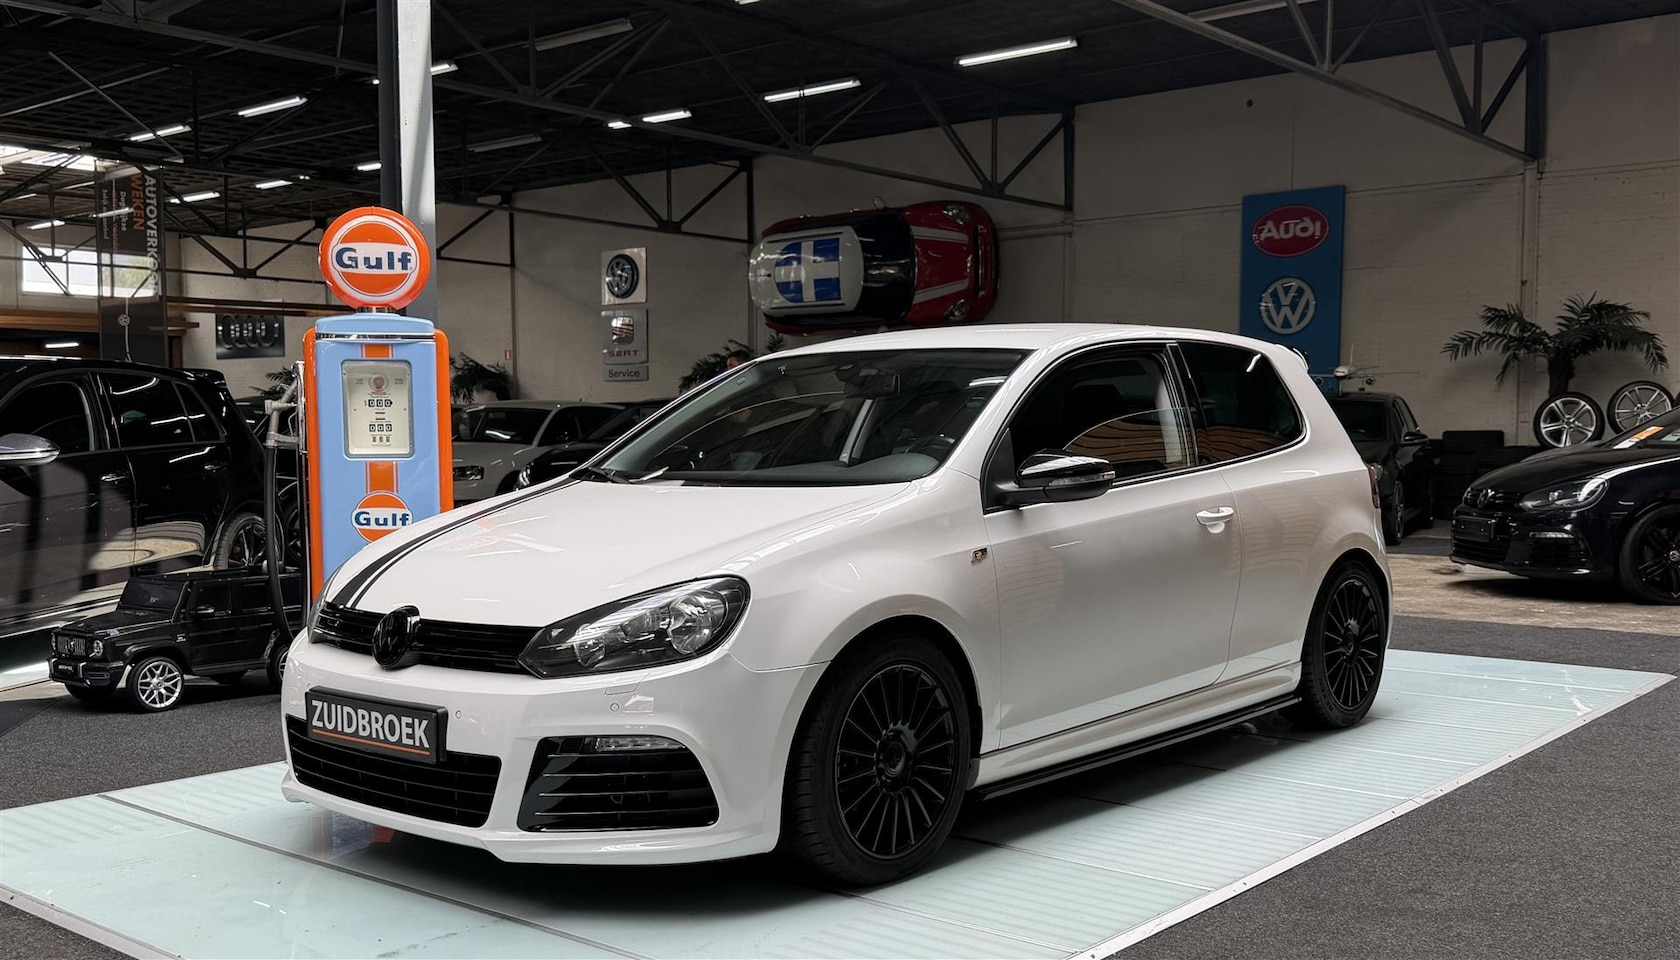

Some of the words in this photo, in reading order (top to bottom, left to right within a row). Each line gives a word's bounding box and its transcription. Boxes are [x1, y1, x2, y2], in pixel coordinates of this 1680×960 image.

[1258, 216, 1321, 241] Audi
[335, 246, 412, 271] Gulf
[608, 349, 639, 357] SEAT
[608, 368, 640, 378] Service
[354, 511, 410, 527] Gulf
[311, 699, 430, 749] ZUIDBROEK
